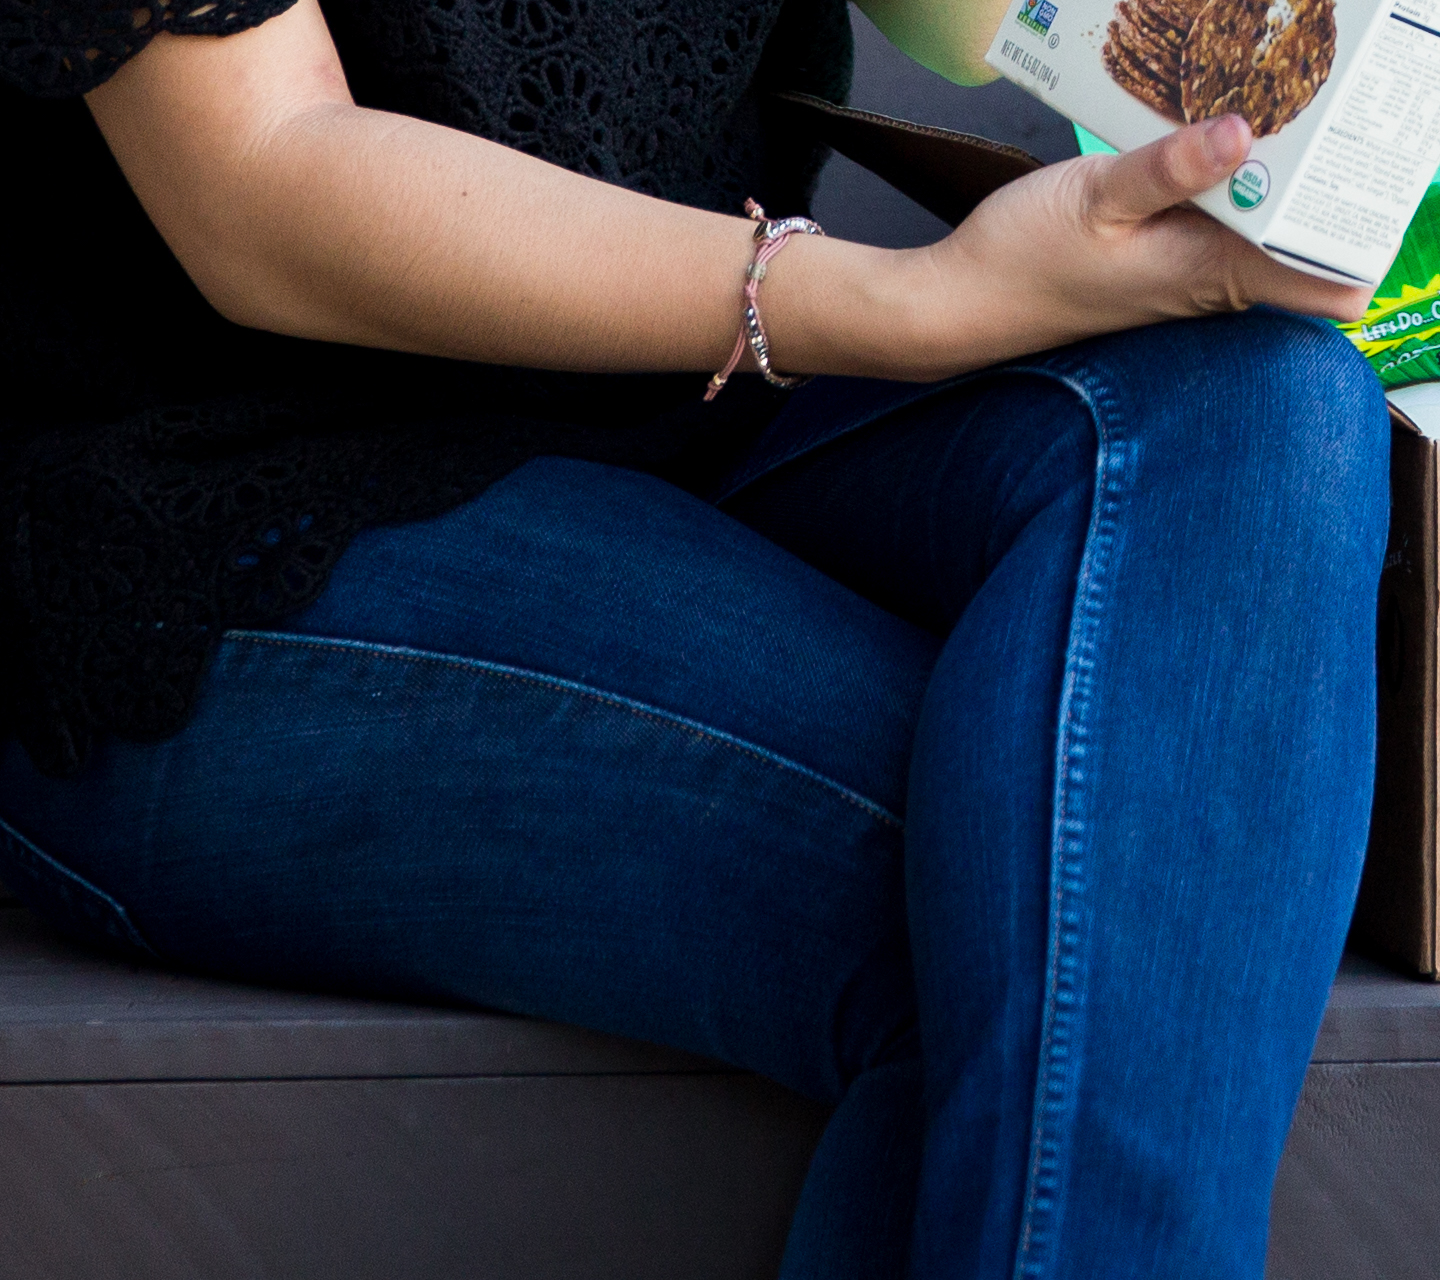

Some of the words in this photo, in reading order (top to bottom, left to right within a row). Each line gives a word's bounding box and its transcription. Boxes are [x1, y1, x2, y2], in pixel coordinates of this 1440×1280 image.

[1001, 40, 1014, 58] NET
[1030, 57, 1041, 76] OZ
[1242, 168, 1262, 188] USDA
